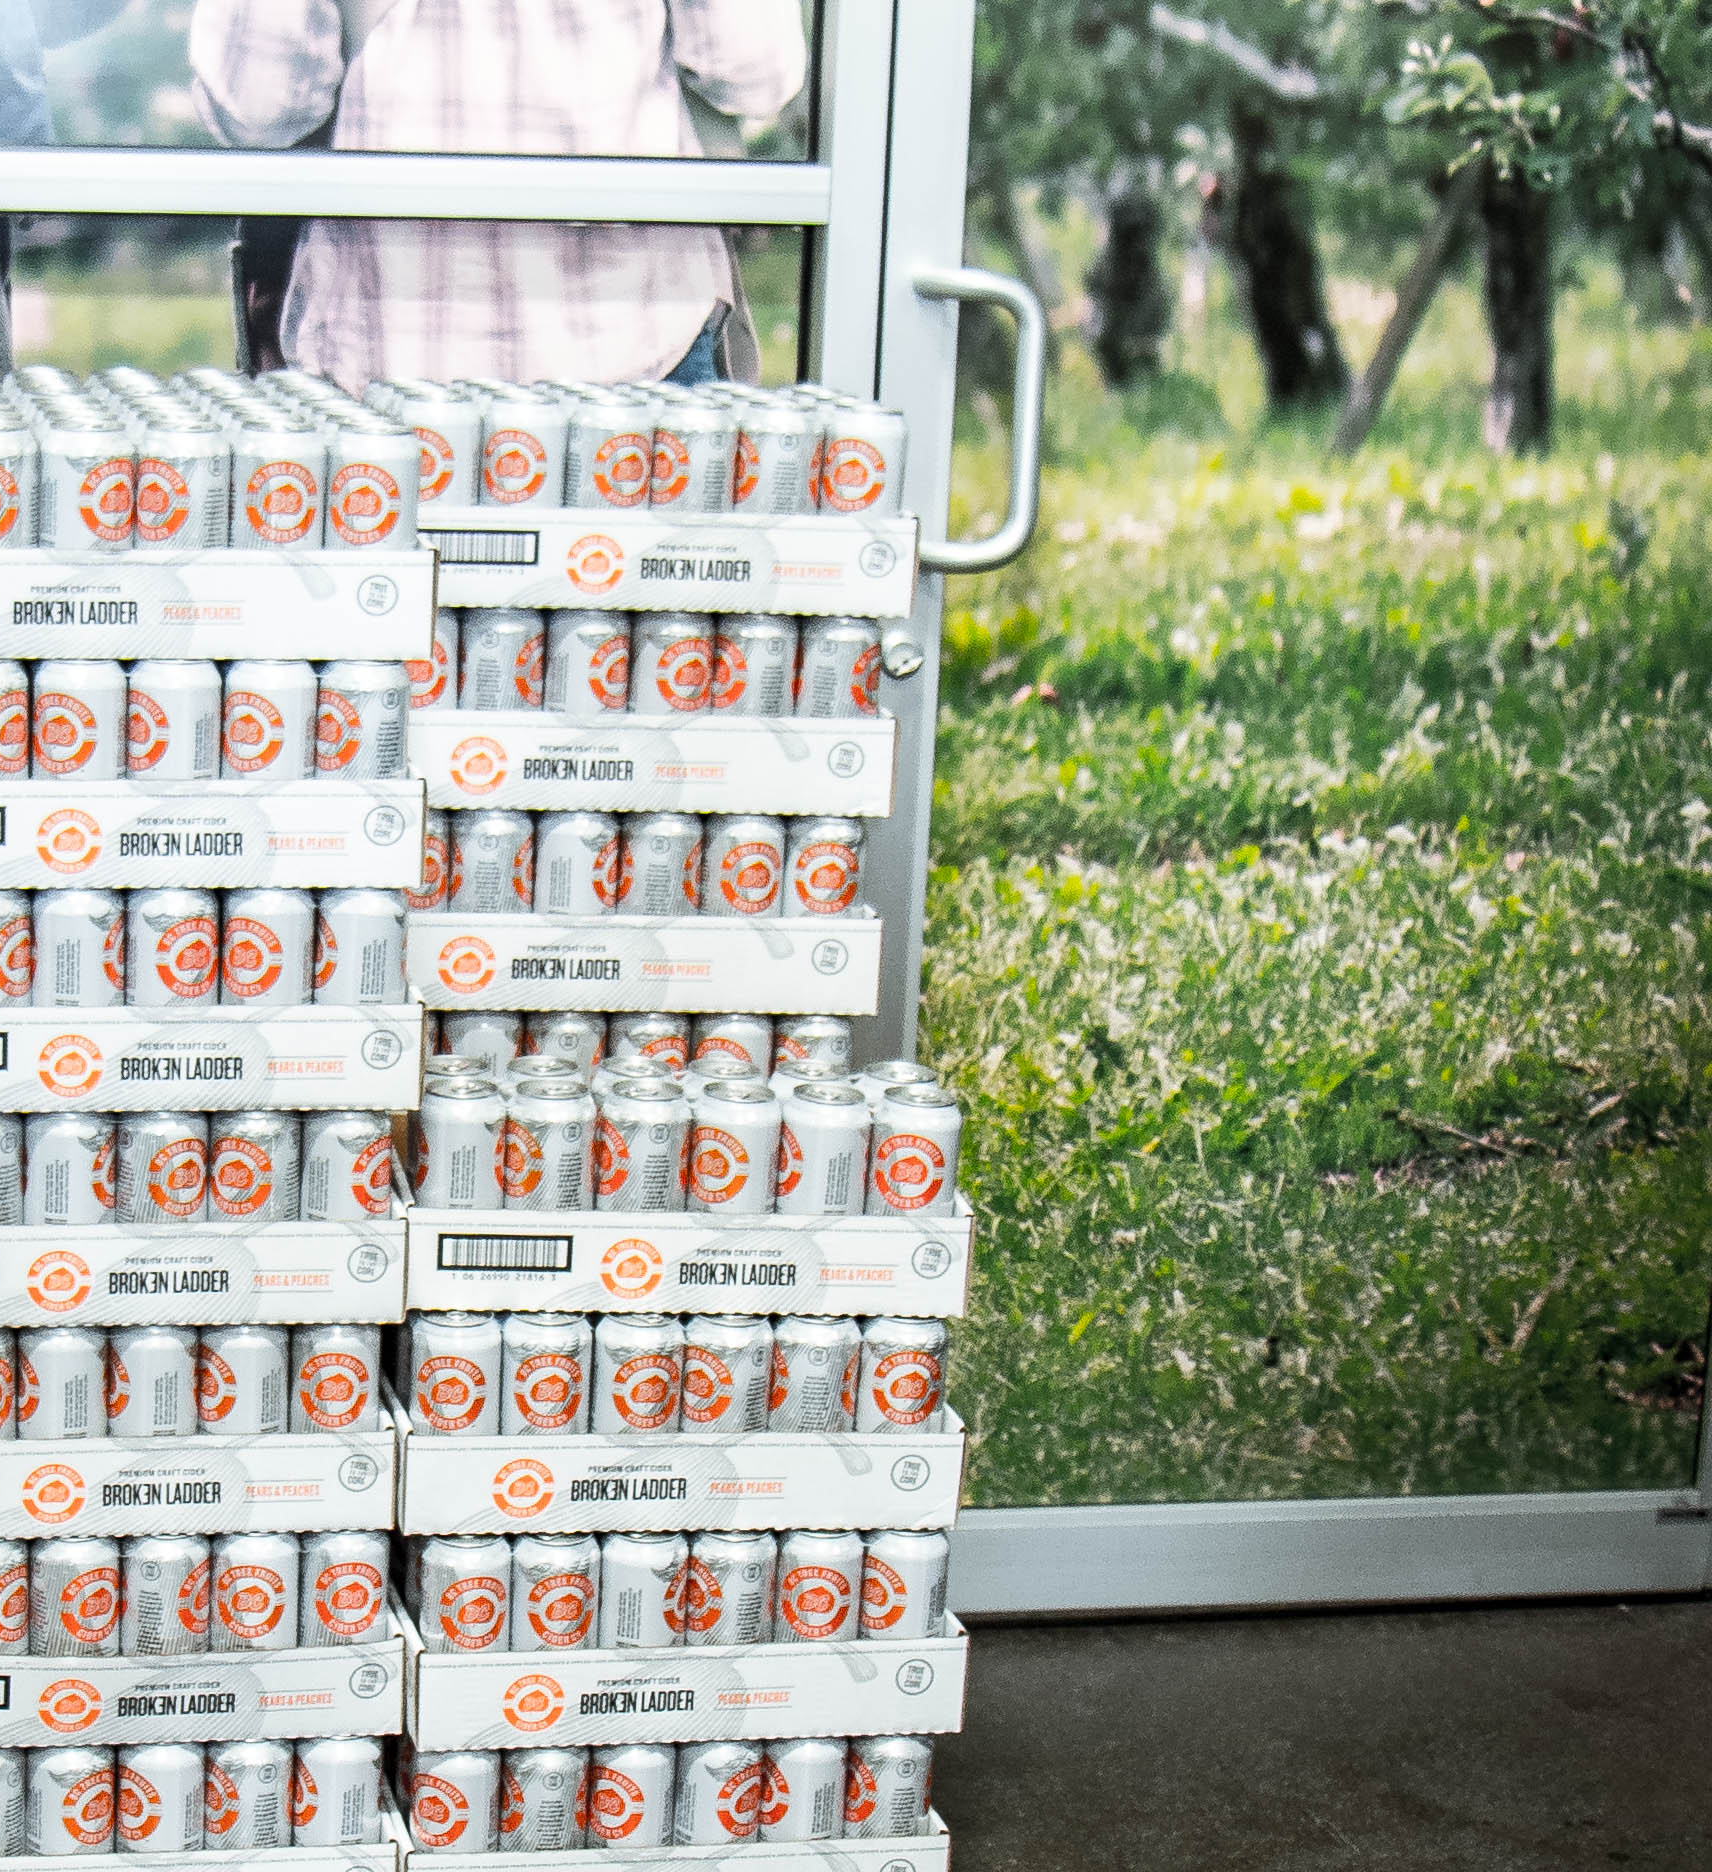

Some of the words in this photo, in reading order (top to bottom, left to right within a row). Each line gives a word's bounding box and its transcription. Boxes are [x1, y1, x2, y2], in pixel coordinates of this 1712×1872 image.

[699, 560, 750, 581] LADDER
[80, 601, 137, 624] LADDER
[582, 760, 633, 780] LADDER
[186, 832, 242, 856] LADDER
[570, 959, 620, 980] LADDER
[186, 1057, 242, 1080] LADDER
[173, 1270, 229, 1293] LADDER
[742, 1264, 796, 1286] LADDER
[166, 1482, 221, 1505] LADDER
[632, 1478, 687, 1500] LADDER
[181, 1693, 235, 1714] LADDER
[641, 1690, 694, 1712] LADDER
